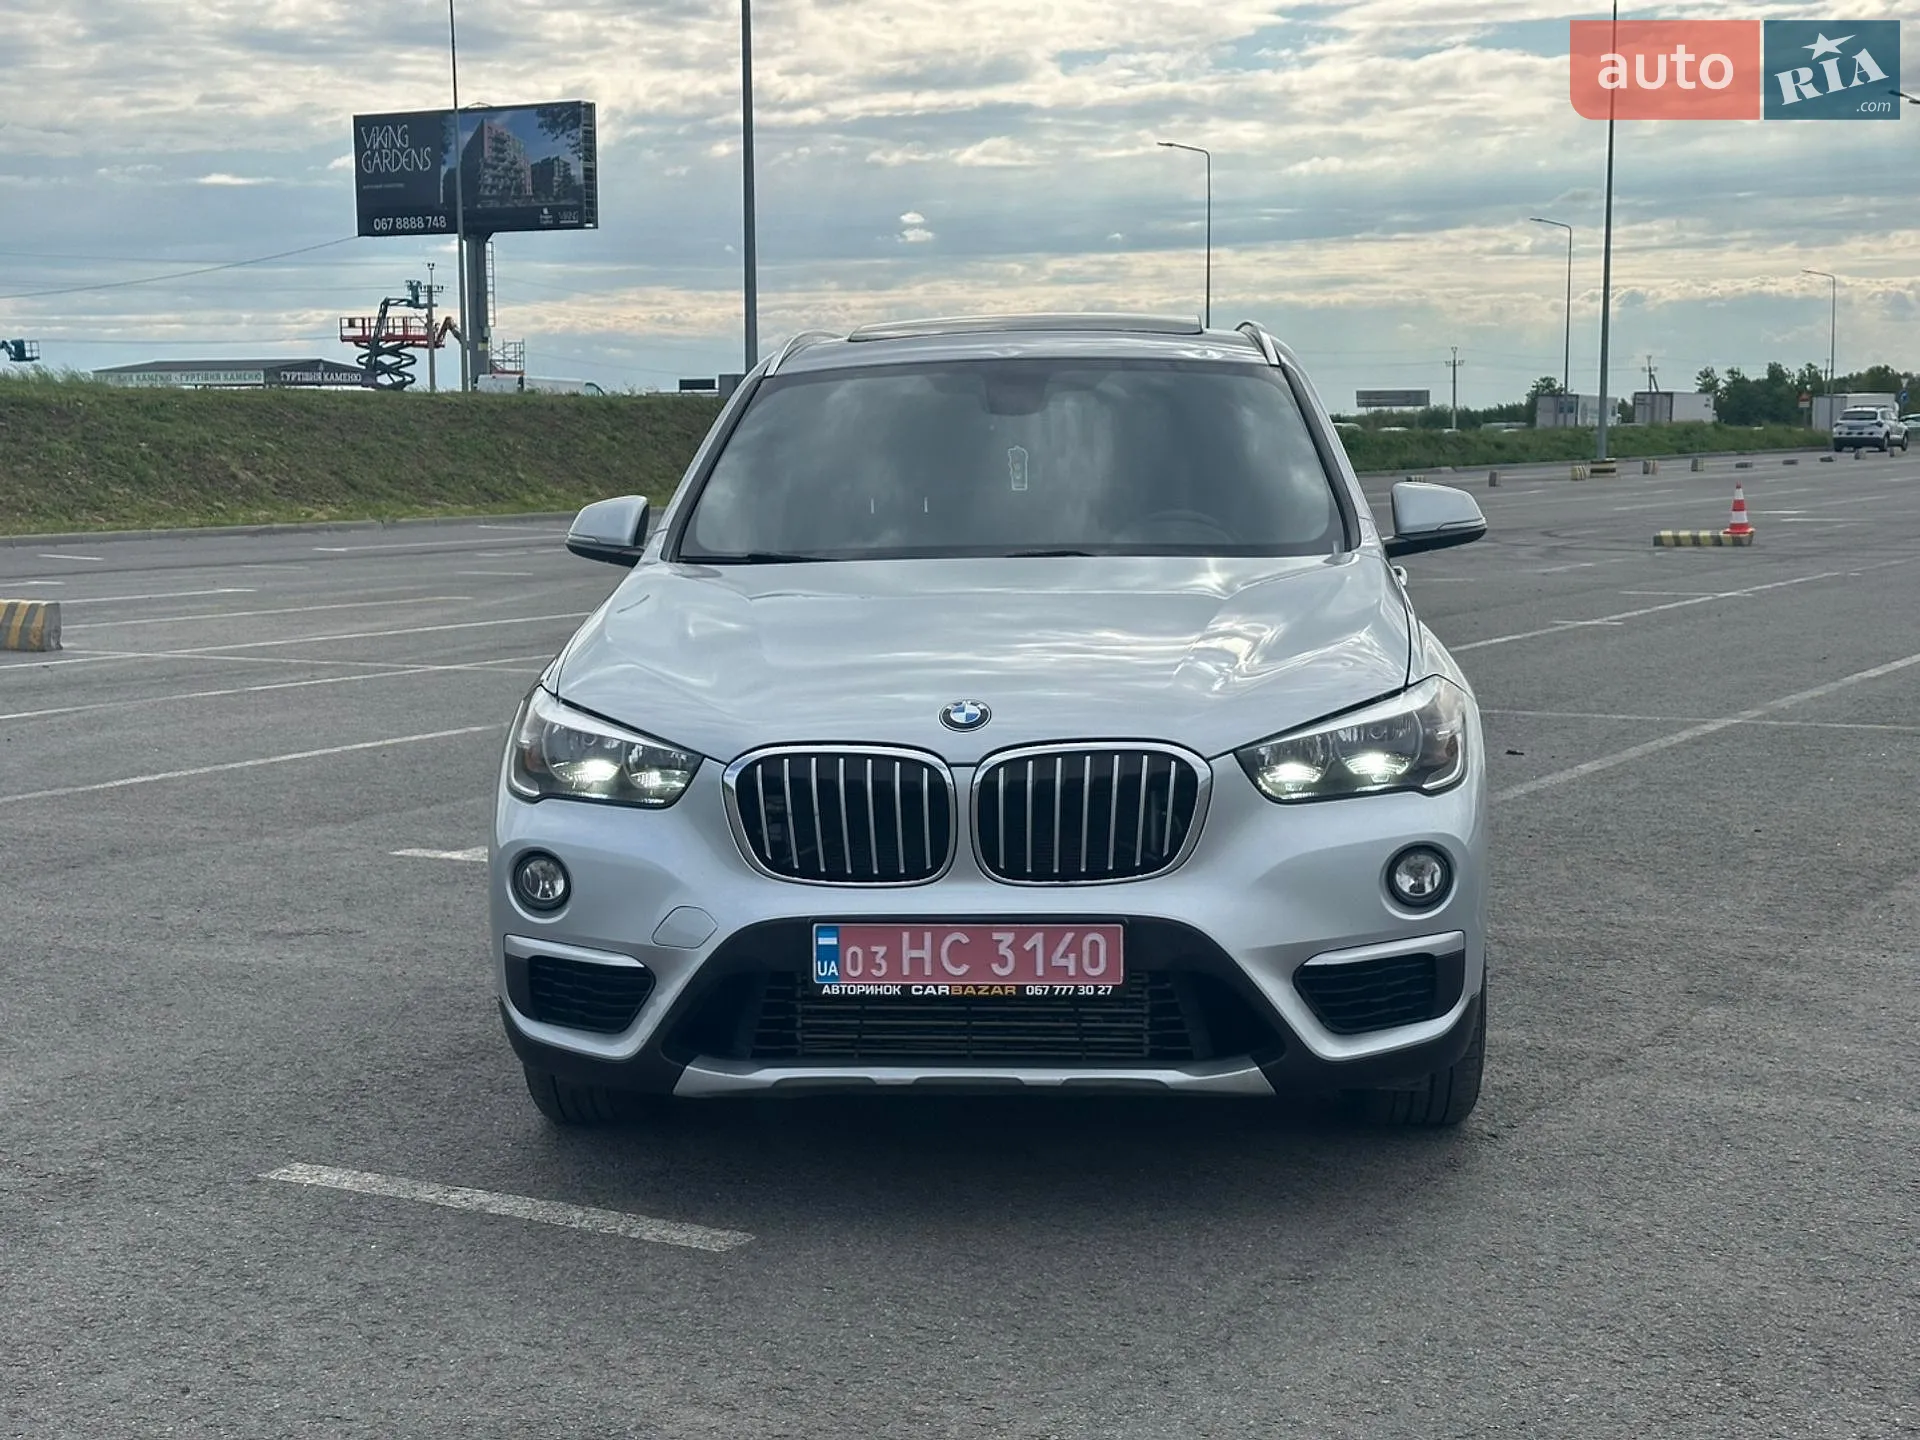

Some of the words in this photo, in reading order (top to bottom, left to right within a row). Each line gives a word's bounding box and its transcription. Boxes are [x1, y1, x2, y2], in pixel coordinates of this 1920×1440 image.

[361, 124, 409, 149] VIKING
[361, 146, 432, 174] GARDENS
[373, 217, 394, 231] 067
[395, 216, 425, 230] 8888
[425, 215, 447, 229] 748
[323, 371, 362, 383] КАМЕНЮ
[845, 945, 888, 978] 03
[901, 931, 971, 977] HC
[990, 931, 1108, 977] 3140
[817, 960, 839, 977] UA
[821, 984, 902, 996] АВТОРИНОК
[910, 984, 1017, 996] CARBAZAR
[1025, 984, 1050, 996] 067
[1052, 984, 1076, 996] 777
[1077, 984, 1095, 996] 30
[1097, 984, 1113, 996] 27
